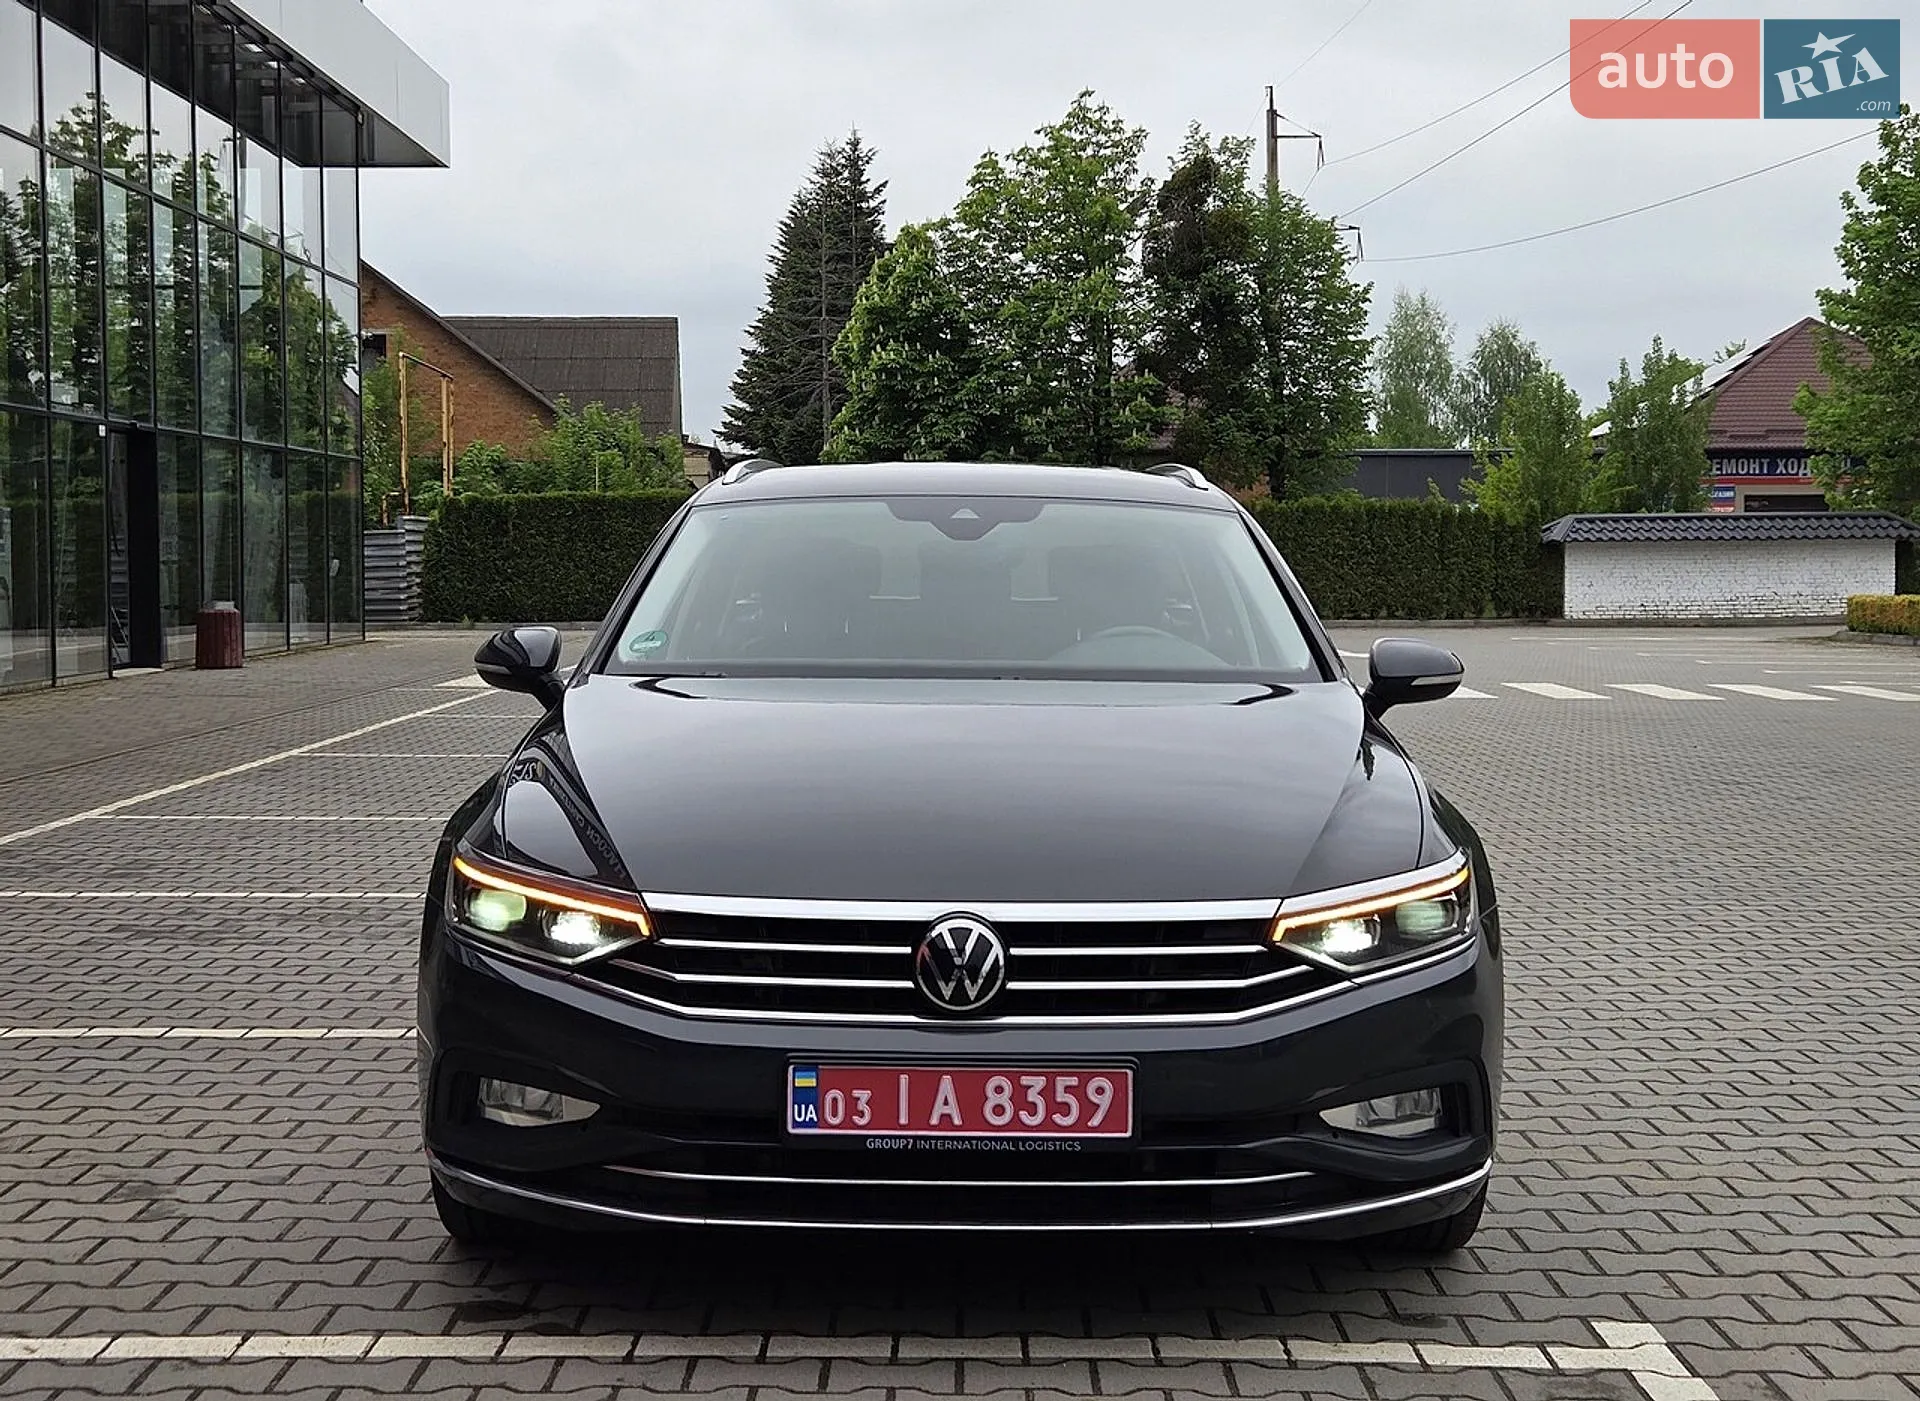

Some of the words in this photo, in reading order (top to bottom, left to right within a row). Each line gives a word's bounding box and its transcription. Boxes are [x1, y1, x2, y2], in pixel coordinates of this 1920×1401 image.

[1710, 458, 1770, 474] ЕМОНТ
[824, 1089, 874, 1127] 03
[982, 1075, 1115, 1127] 8359
[794, 1103, 818, 1123] UA
[866, 1138, 914, 1150] GROUP7
[916, 1139, 1016, 1151] INTERNATIONAL
[1018, 1141, 1082, 1152] LOGISTICS
